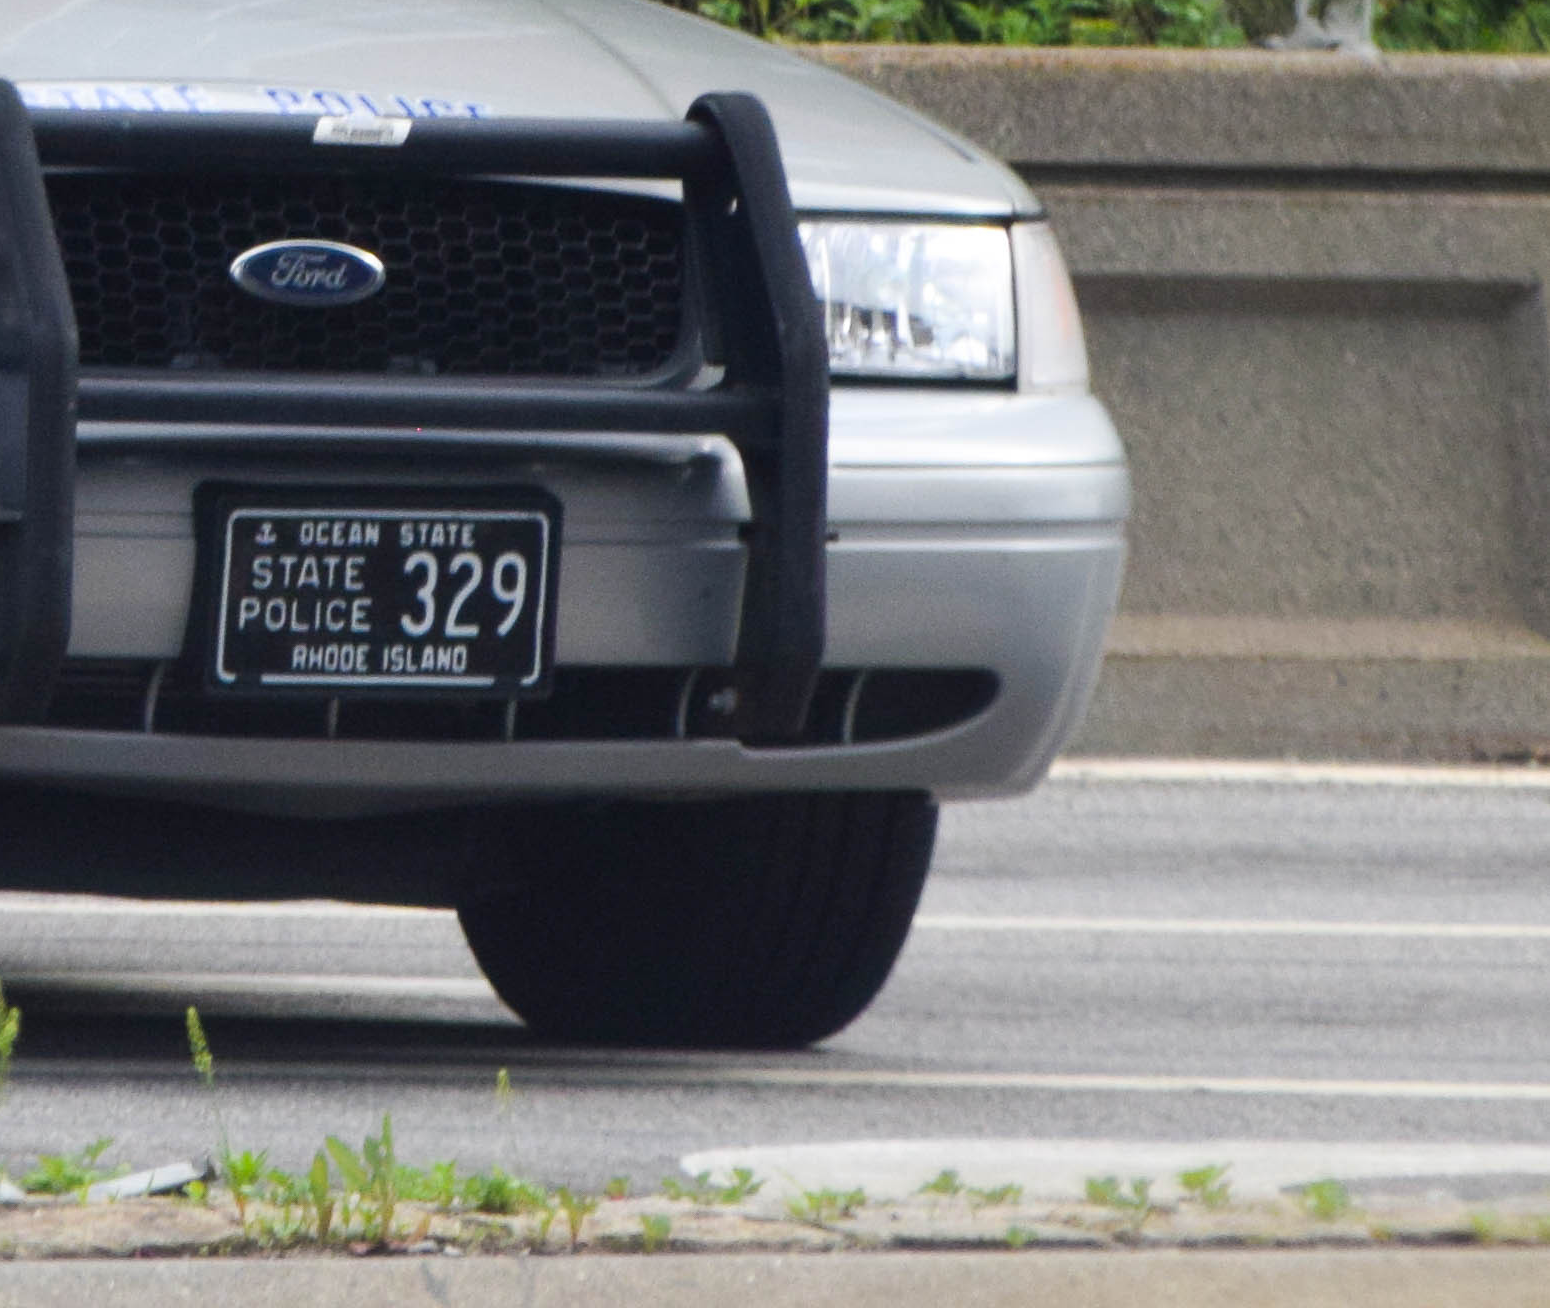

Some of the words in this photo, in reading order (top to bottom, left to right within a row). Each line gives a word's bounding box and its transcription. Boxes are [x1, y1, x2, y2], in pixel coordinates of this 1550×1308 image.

[270, 251, 348, 289] Ford
[299, 521, 380, 547] OCEAN
[399, 522, 476, 548] STATE
[251, 555, 367, 591] STATE
[399, 550, 528, 638] 329
[237, 597, 373, 633] POLICE
[291, 643, 371, 673] RHODE
[382, 644, 468, 674] ISLAND
